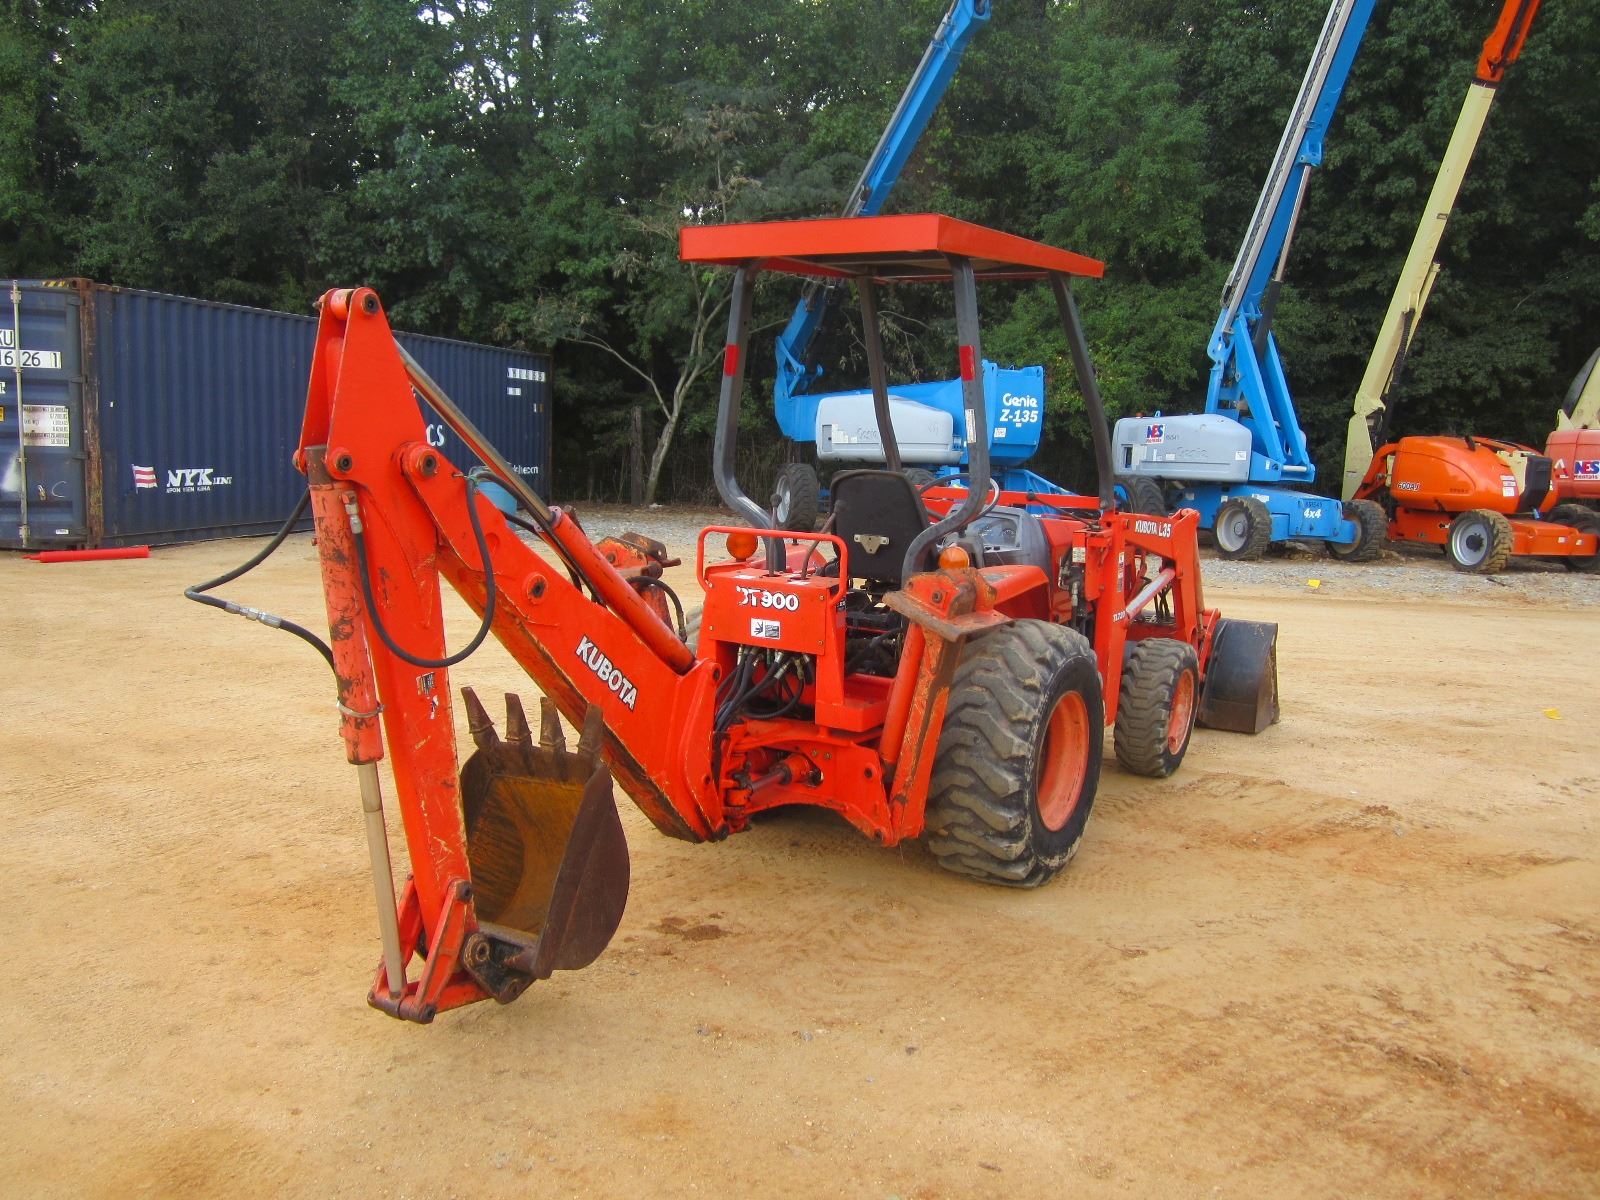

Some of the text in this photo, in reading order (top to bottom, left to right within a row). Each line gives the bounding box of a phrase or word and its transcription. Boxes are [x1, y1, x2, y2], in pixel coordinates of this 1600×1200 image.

[1003, 393, 1038, 407] Genie
[1000, 409, 1038, 422] Z-135
[1575, 461, 1600, 474] NES
[167, 468, 213, 487] NYK
[1135, 520, 1171, 537] KUBOTA L35
[575, 636, 638, 712] KUBOTA
